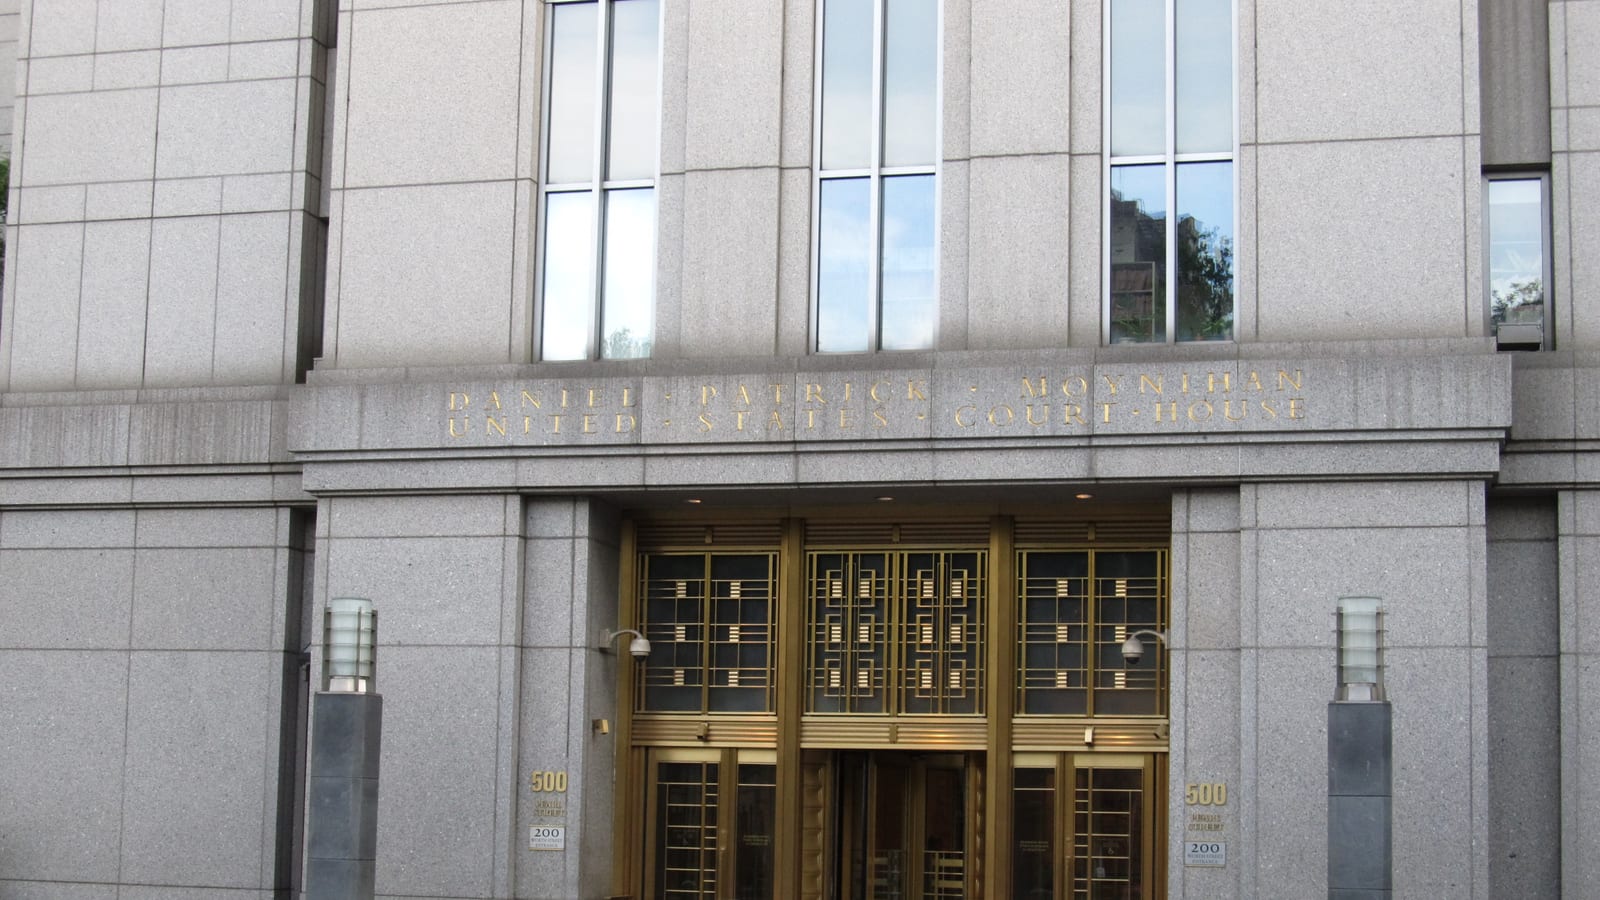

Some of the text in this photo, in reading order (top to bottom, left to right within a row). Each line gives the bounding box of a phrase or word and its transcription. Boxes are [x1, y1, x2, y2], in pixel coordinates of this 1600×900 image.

[449, 368, 1304, 411] DANIEL PATRICK MOYNIHAN
[448, 397, 1306, 439] UNITED STATES COURT HOUSE
[532, 770, 568, 793] 500
[1185, 783, 1227, 806] 500
[534, 828, 560, 838] 200
[1191, 843, 1220, 853] 200
